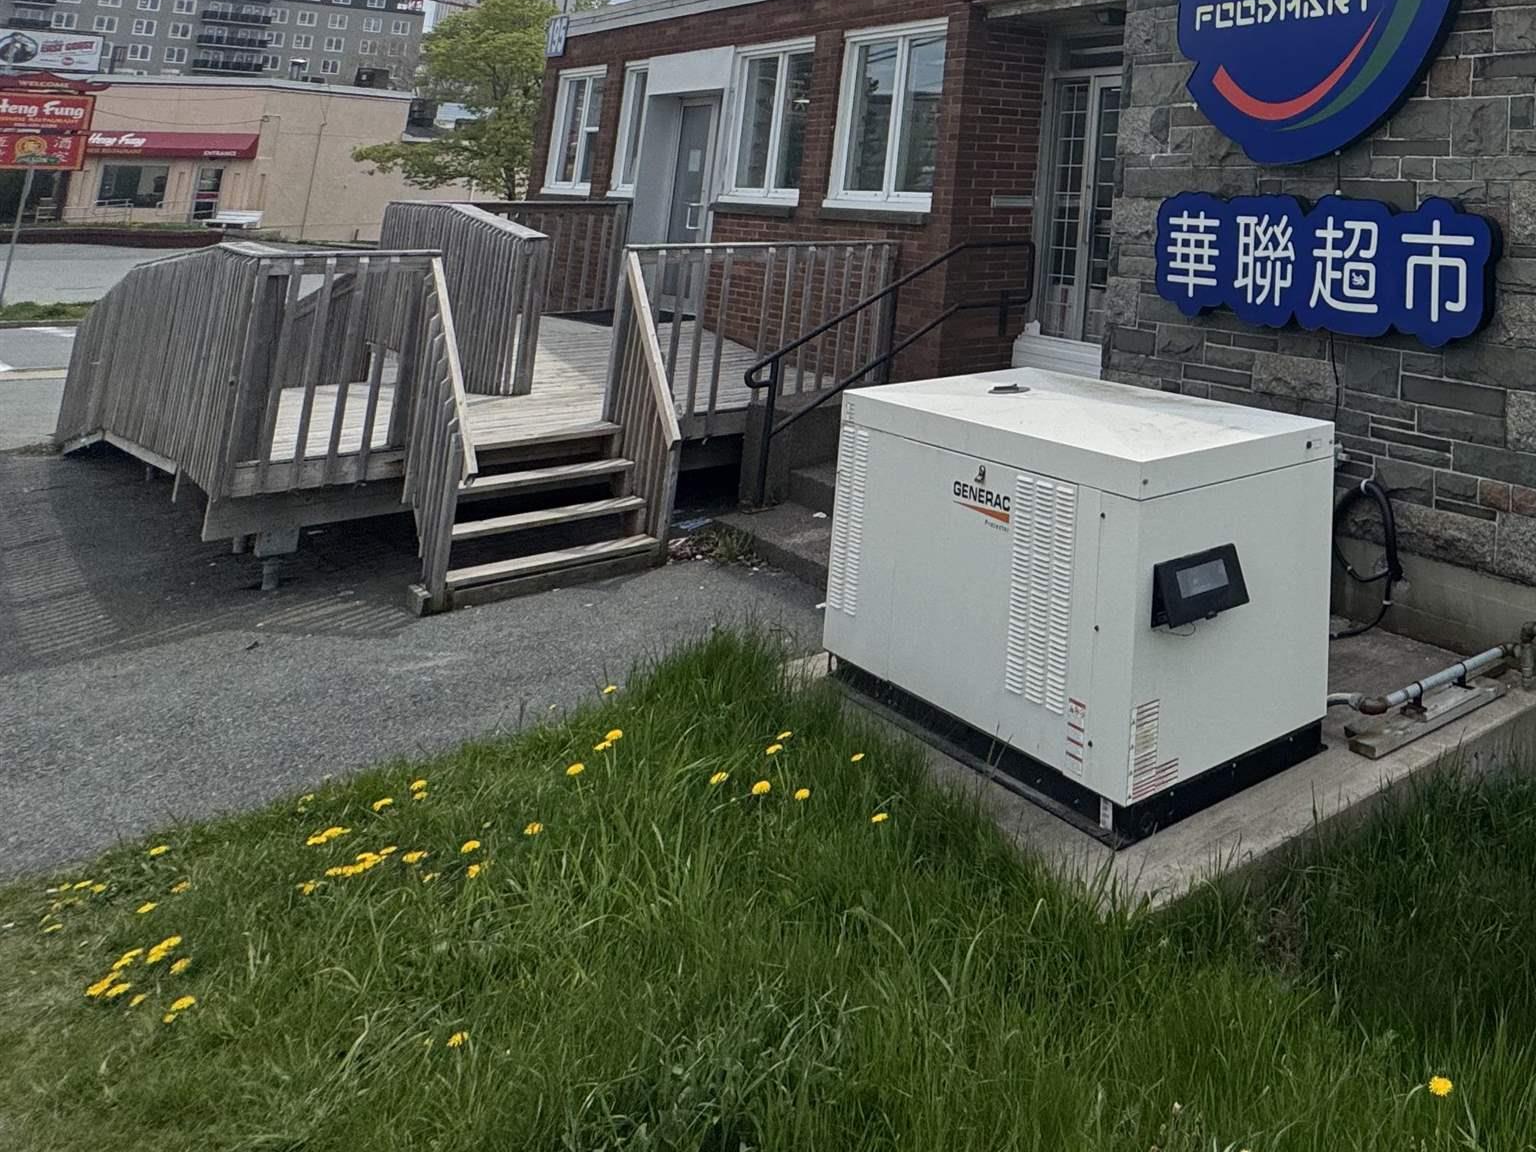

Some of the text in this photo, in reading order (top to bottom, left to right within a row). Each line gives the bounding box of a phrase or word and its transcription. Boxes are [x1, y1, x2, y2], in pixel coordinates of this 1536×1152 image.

[547, 16, 568, 54] 195
[18, 80, 70, 89] WELCOME
[43, 100, 84, 120] Fung
[88, 132, 146, 147] Heng Fung
[1165, 209, 1475, 323] 華聯超市
[953, 480, 1011, 512] GENERAC
